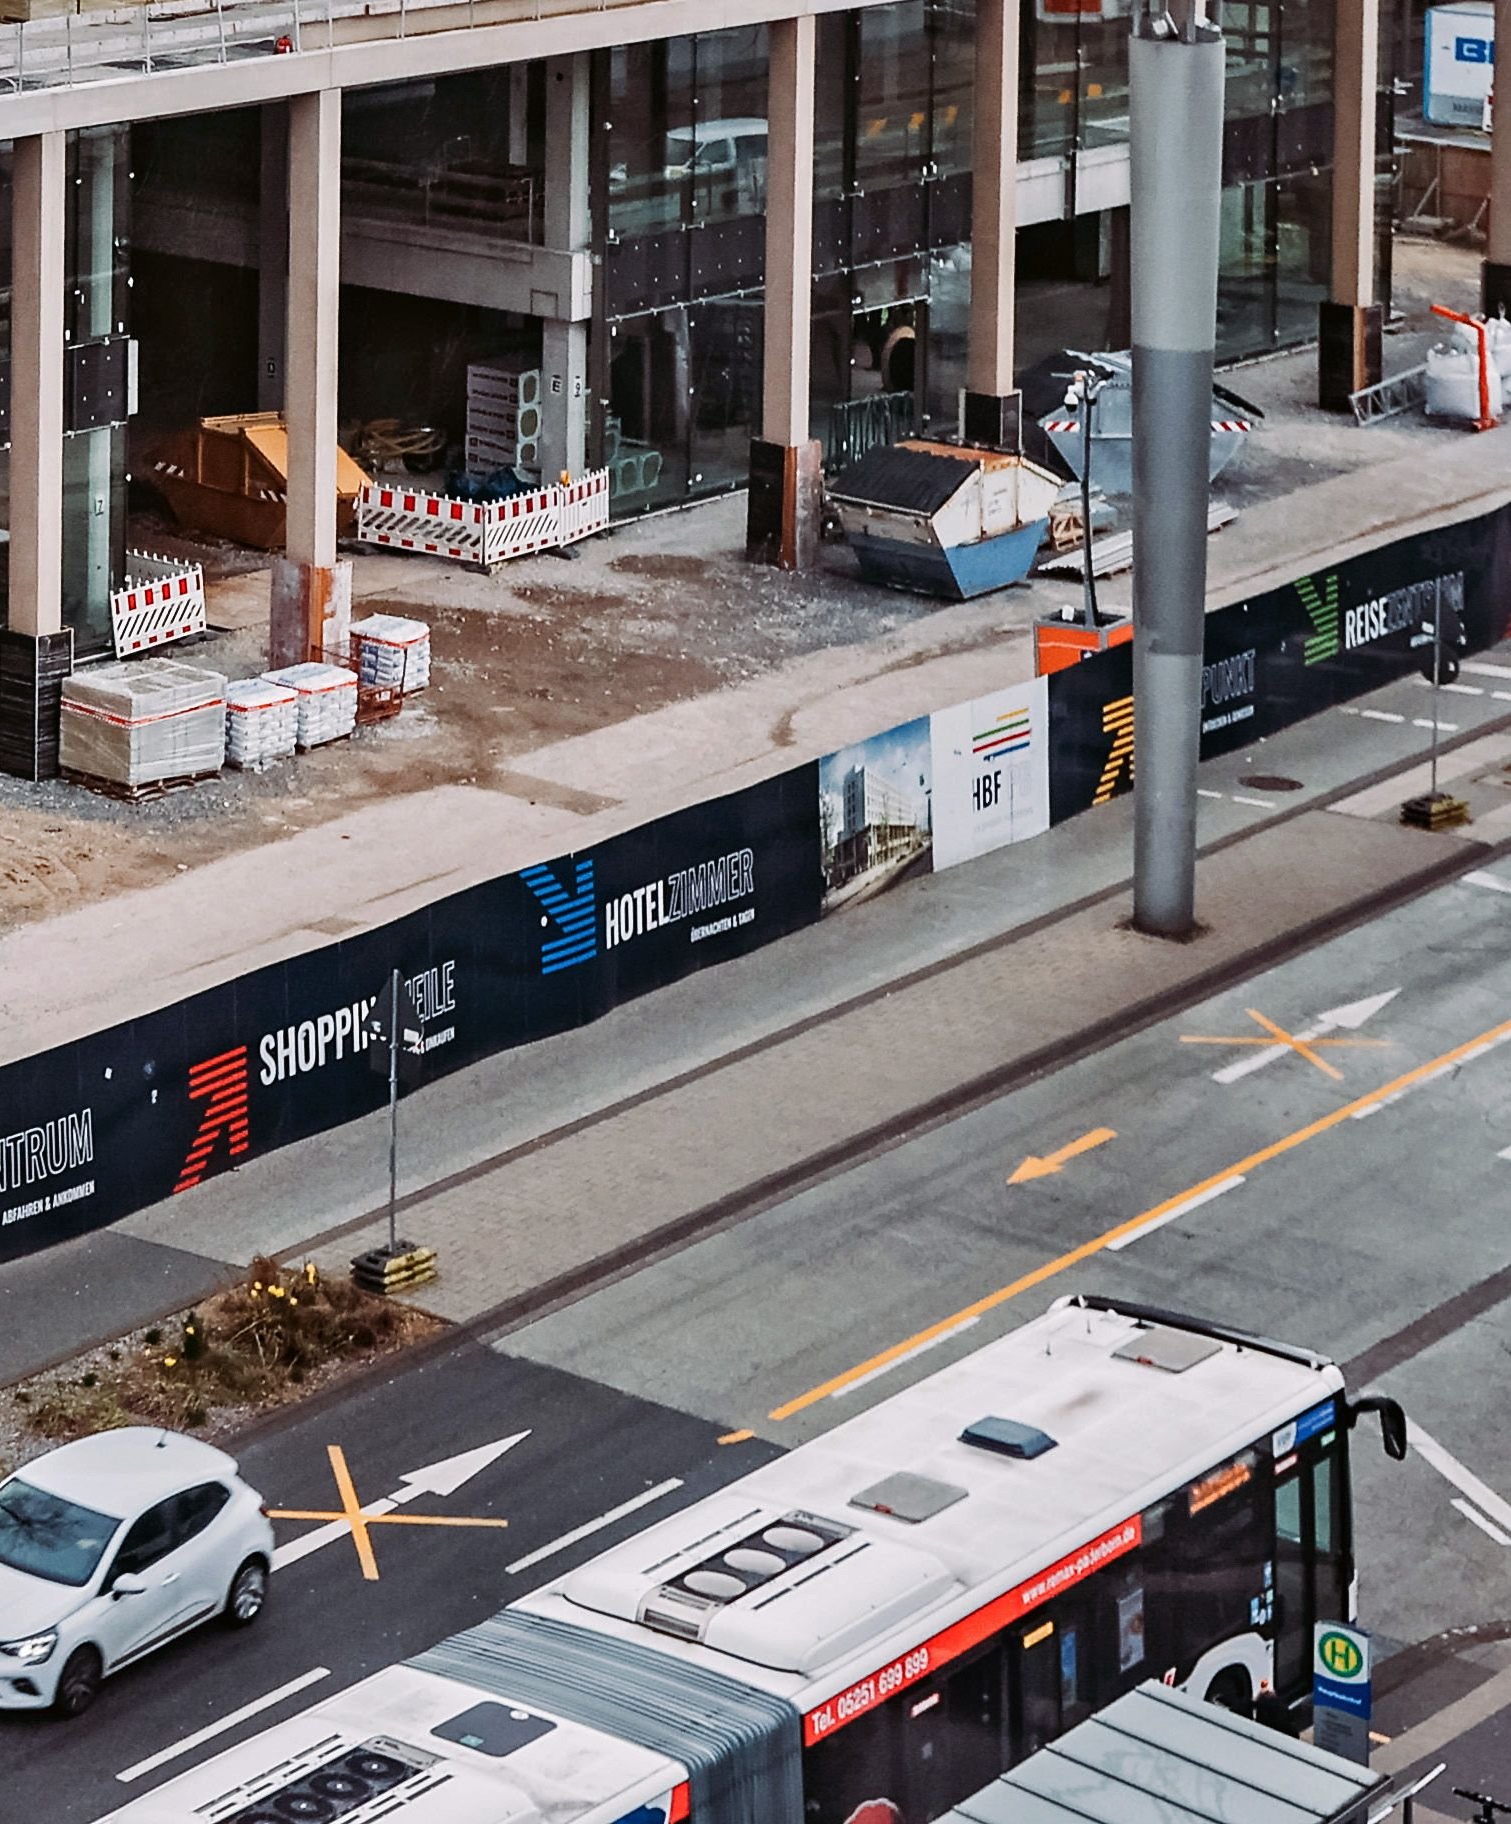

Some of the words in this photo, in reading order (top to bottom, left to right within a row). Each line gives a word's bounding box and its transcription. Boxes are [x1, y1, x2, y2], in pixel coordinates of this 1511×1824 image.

[1202, 648, 1256, 708] PUNKT
[972, 771, 1002, 812] HBF
[606, 848, 754, 949] HOTELZIMMER
[2, 1198, 43, 1226] ABFAHREN
[52, 1179, 95, 1210] ANKOMMEN
[811, 1703, 836, 1735] Tel.
[837, 1683, 876, 1720] 05251
[878, 1666, 904, 1696] 699
[905, 1648, 929, 1679] 899
